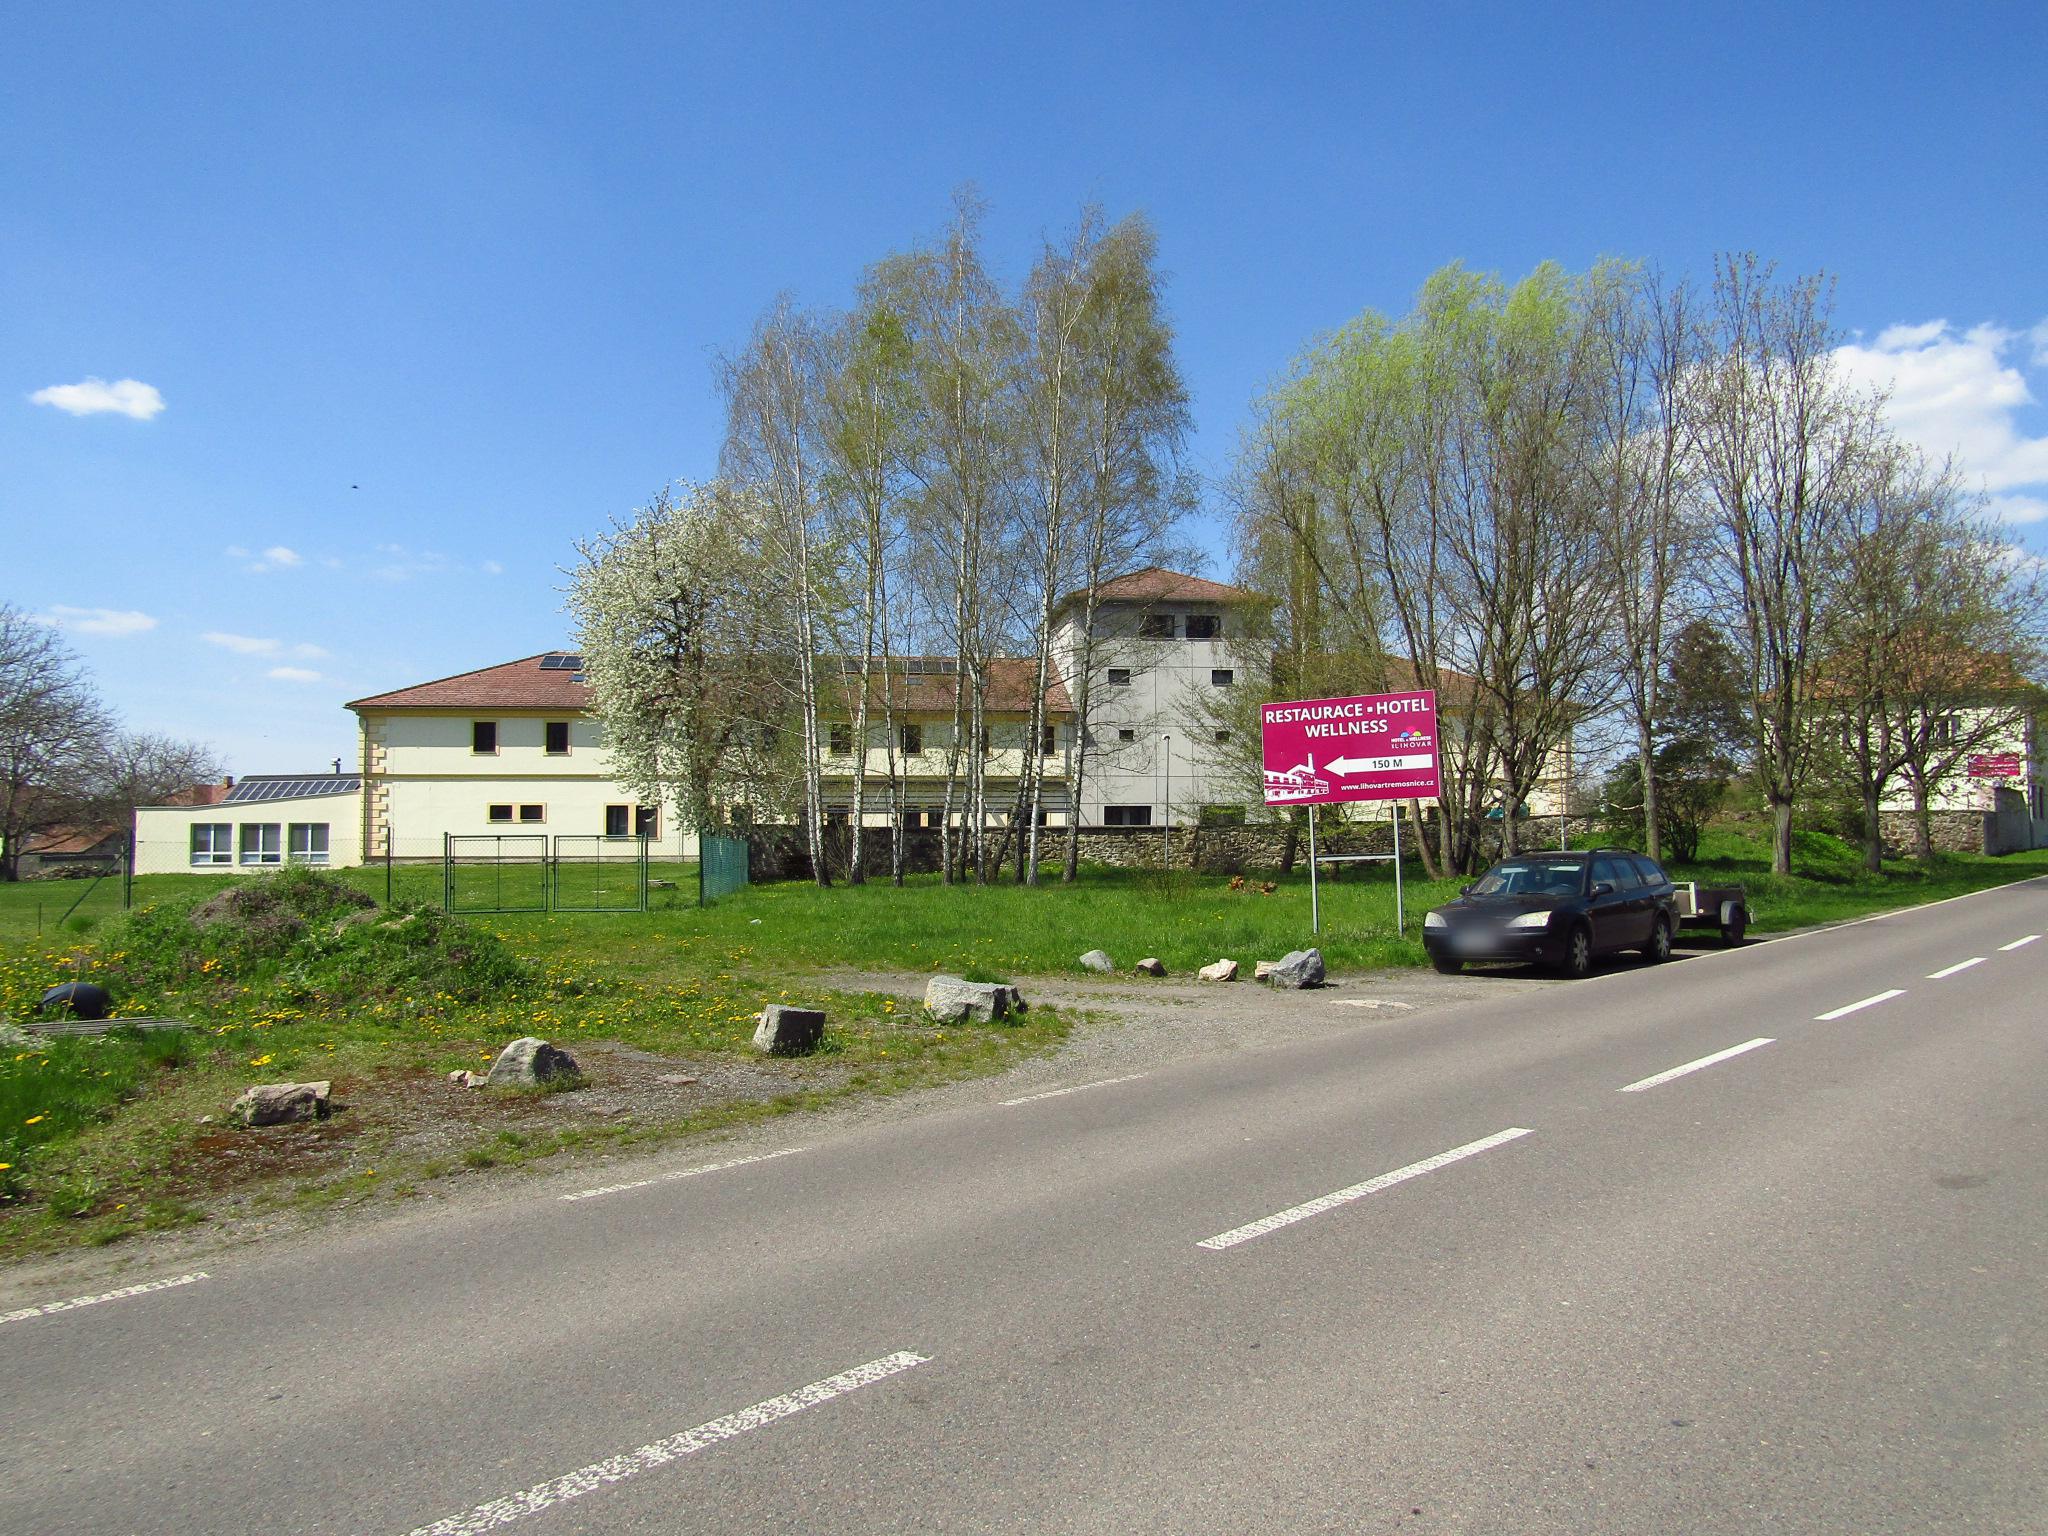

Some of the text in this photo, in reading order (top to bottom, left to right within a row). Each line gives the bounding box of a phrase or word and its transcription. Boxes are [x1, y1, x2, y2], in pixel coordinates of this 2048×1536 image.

[1265, 698, 1429, 723] RESTAURACE HOTEL
[1305, 719, 1388, 738] WELLNESS
[1372, 758, 1403, 769] 150 M
[1341, 780, 1434, 791] www.lihovartremosnice.cz
